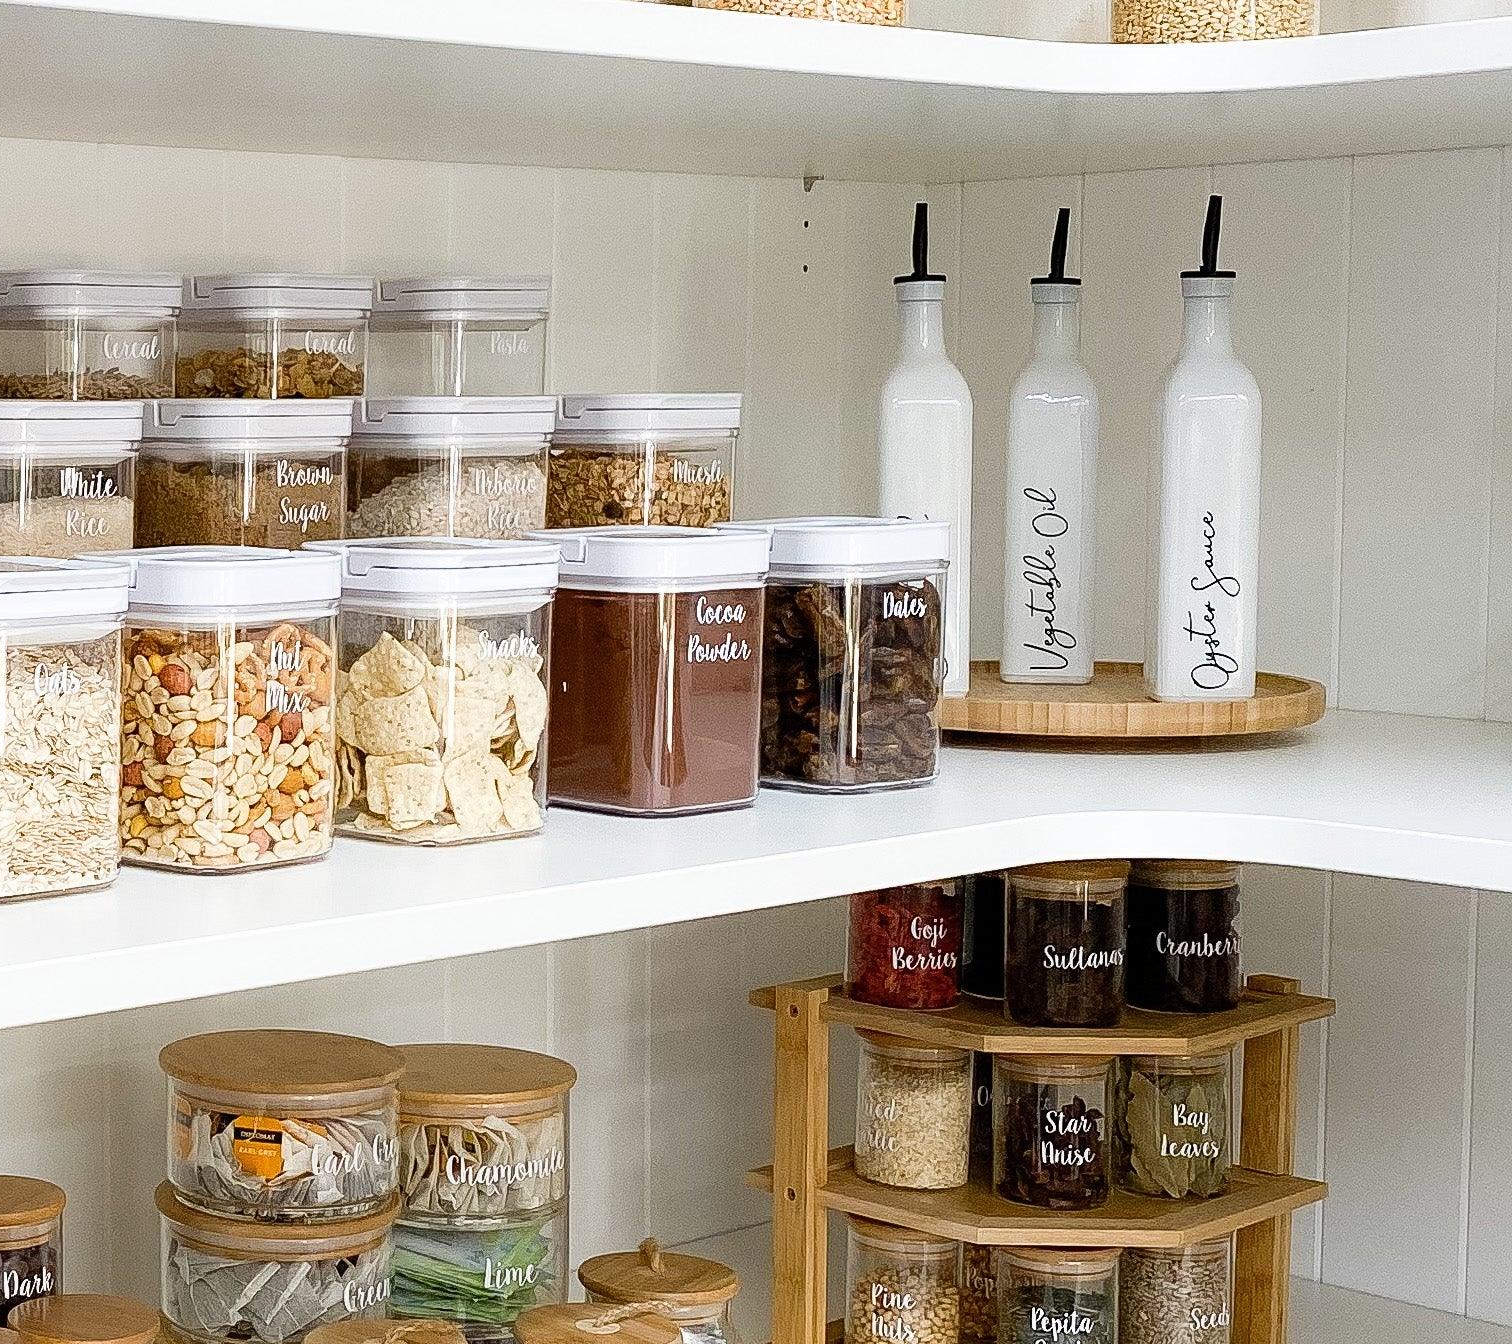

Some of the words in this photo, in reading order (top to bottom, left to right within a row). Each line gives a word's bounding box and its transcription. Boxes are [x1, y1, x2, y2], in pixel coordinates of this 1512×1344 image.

[303, 329, 357, 357] Cereal
[59, 466, 118, 501] White
[275, 459, 333, 488] Brown
[671, 457, 724, 485] Muesli
[64, 506, 109, 538] Rice
[278, 496, 330, 533] Sugar
[1022, 486, 1069, 539] Oil
[1190, 510, 1241, 598] Sauce
[696, 596, 746, 626] Cocoa
[882, 591, 928, 620] Dates
[1017, 546, 1077, 672] Vegetable
[268, 638, 304, 676] Nut
[475, 629, 541, 664] Snacks
[687, 634, 752, 664] Powder
[1183, 605, 1240, 691] Oyster
[33, 662, 81, 699] Oats
[264, 678, 308, 714] Mix
[910, 916, 948, 952] Goji
[891, 945, 959, 972] Berries
[1042, 944, 1125, 972] Sultanas
[1045, 1109, 1093, 1137] Star
[1171, 1103, 1210, 1137] Bay
[310, 1141, 366, 1176] Earl
[1041, 1141, 1096, 1167] Anise
[1160, 1134, 1221, 1161] Leaves
[2, 1266, 56, 1300] Dark
[483, 1256, 539, 1291] Lime
[870, 1282, 917, 1312] Pine
[870, 1314, 917, 1343] Nuts
[1030, 1306, 1095, 1337] Pepita
